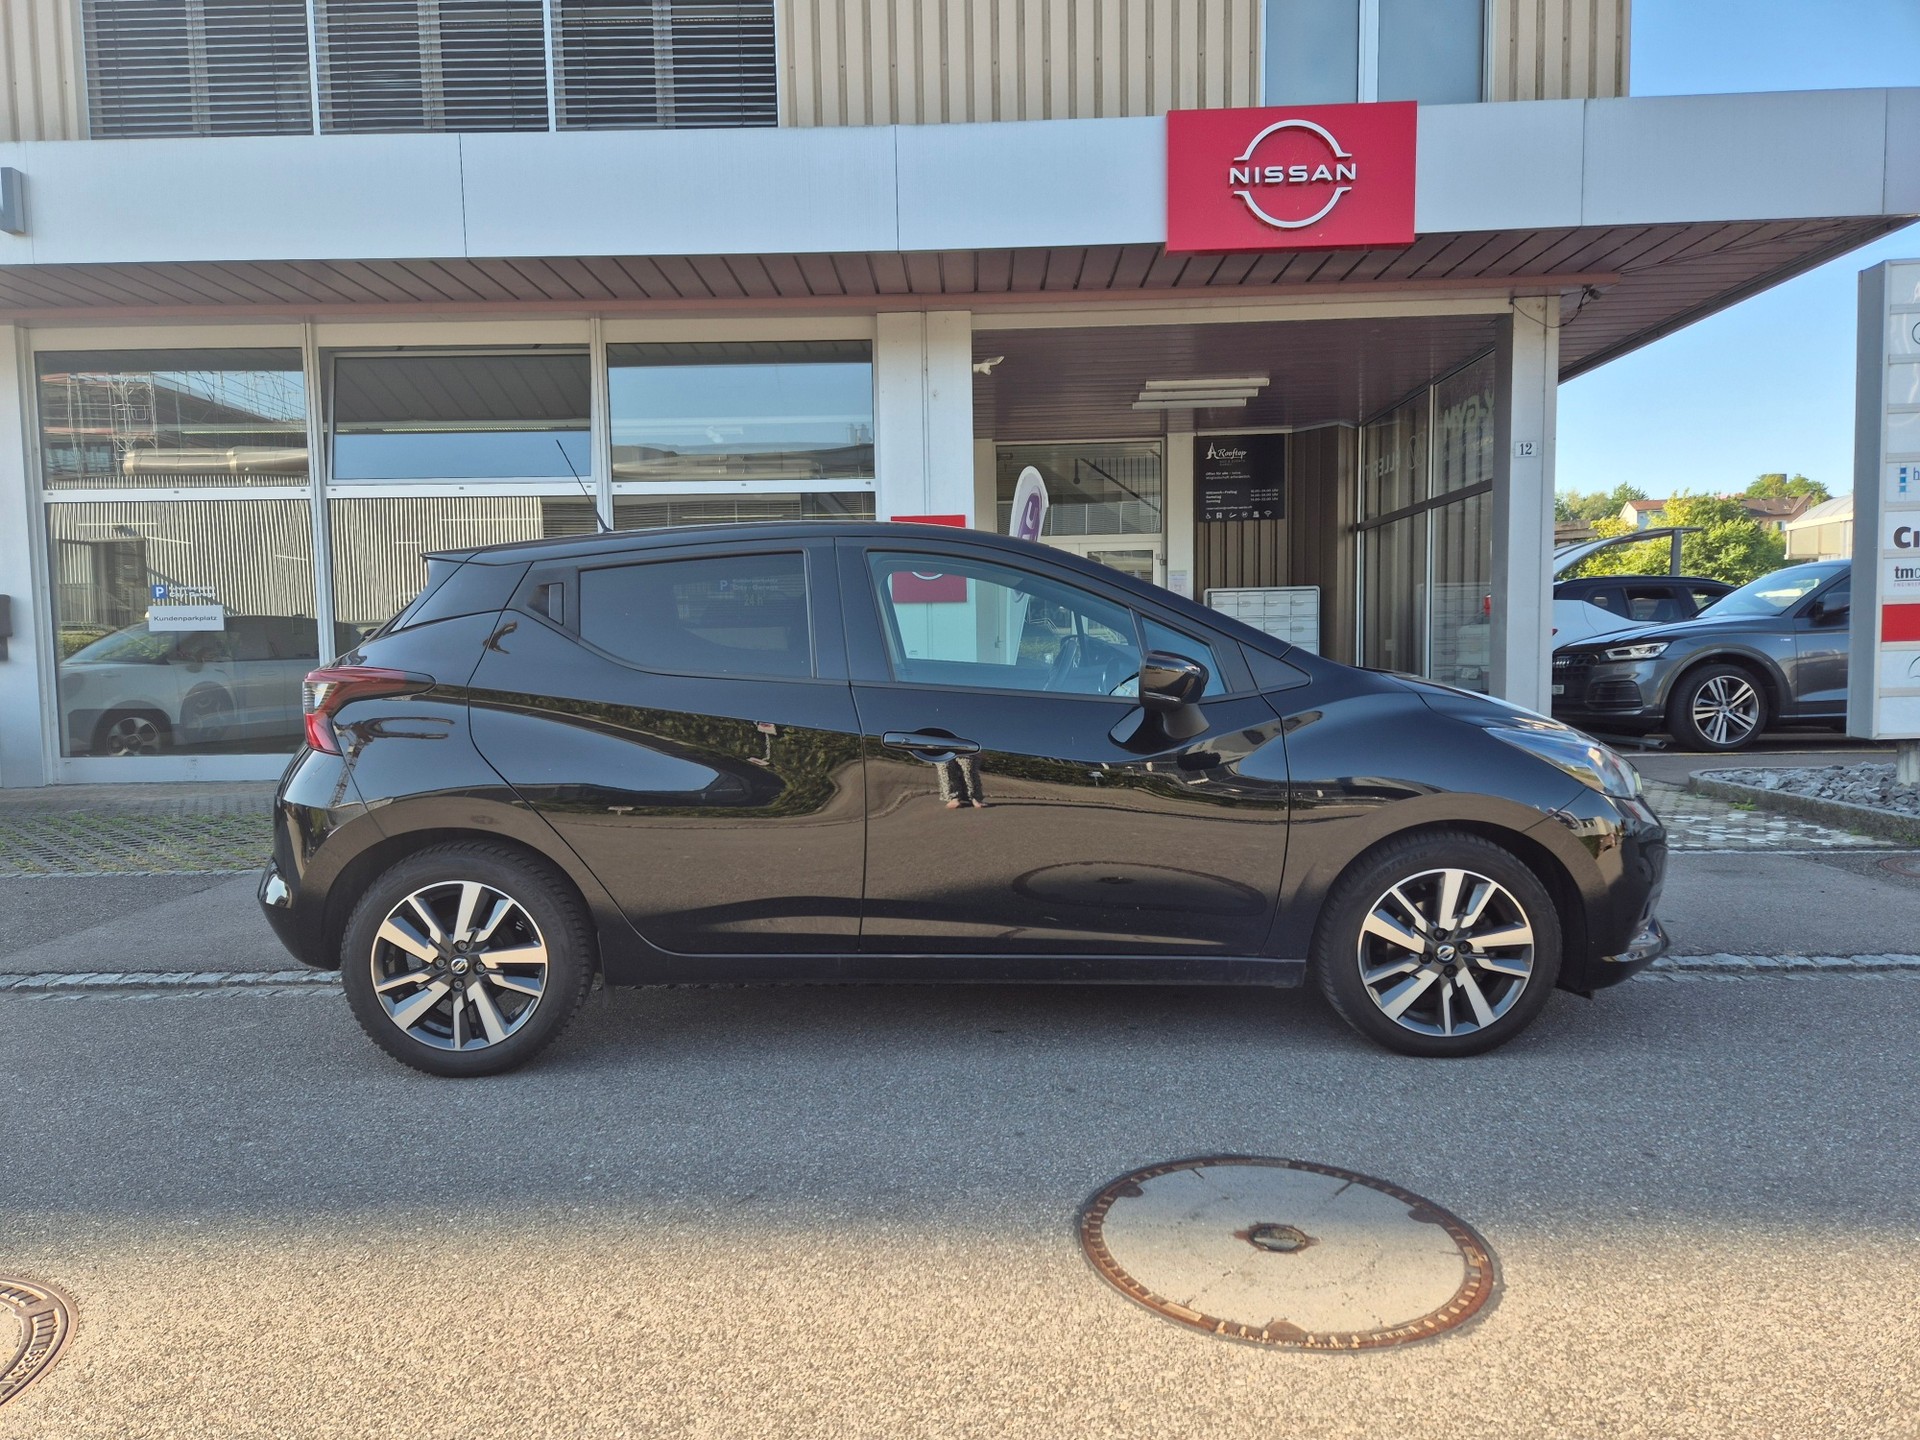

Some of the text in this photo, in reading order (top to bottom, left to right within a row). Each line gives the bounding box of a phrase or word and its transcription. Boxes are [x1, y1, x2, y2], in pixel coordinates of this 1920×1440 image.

[1229, 163, 1356, 184] NISSAN
[1218, 447, 1247, 460] Rooftop
[1520, 442, 1533, 456] 12
[155, 586, 164, 597] P
